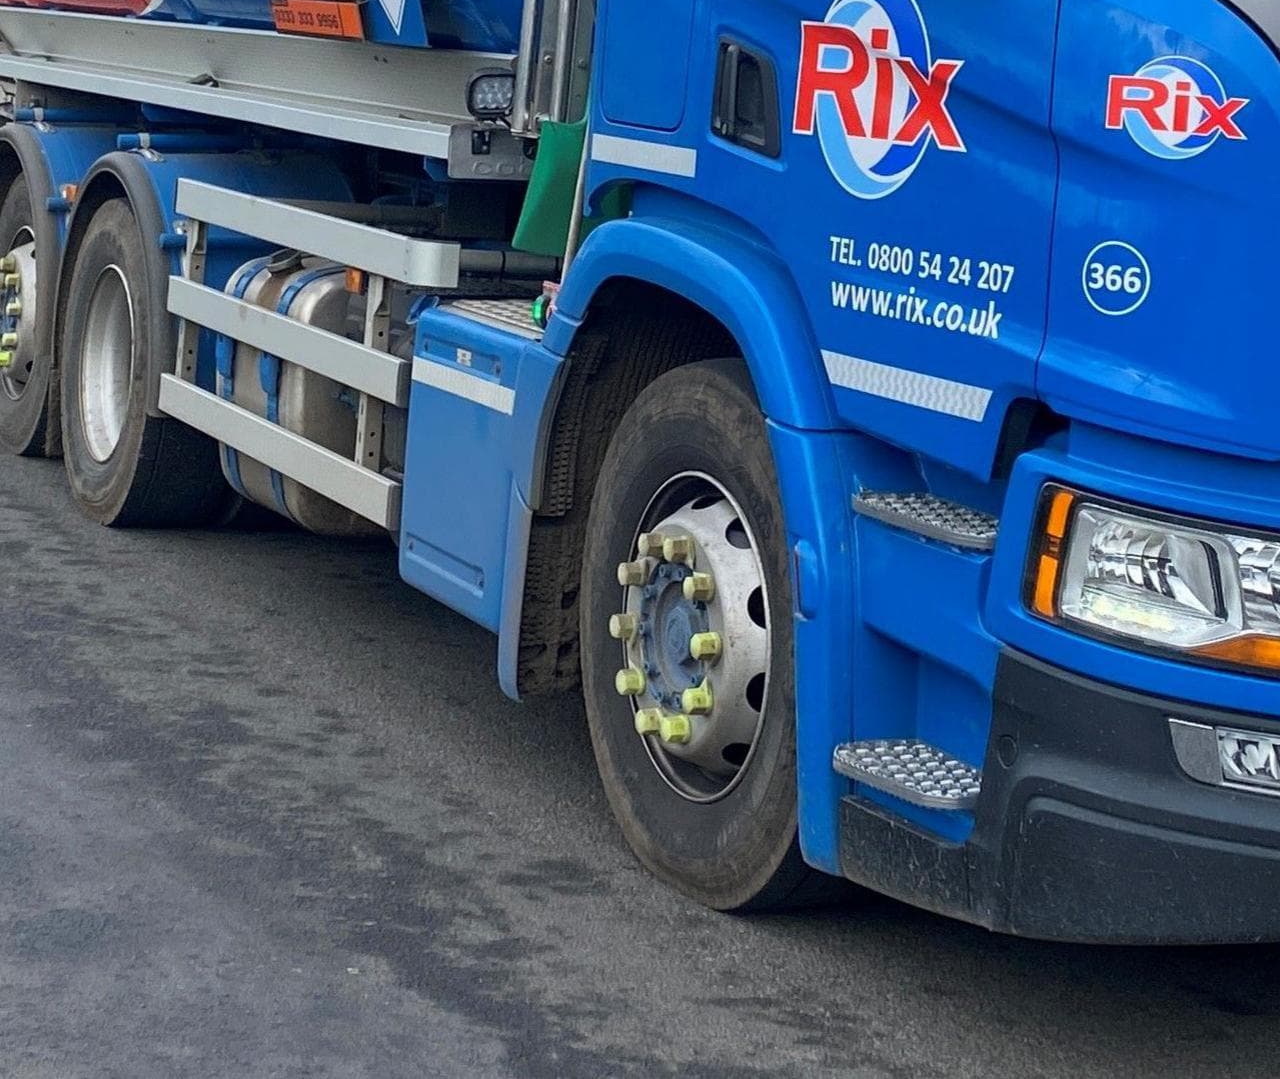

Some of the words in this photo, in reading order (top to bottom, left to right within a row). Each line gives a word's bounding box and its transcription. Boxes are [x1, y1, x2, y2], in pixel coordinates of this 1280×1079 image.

[792, 20, 967, 153] Rix
[1105, 74, 1251, 141] Rix
[830, 235, 862, 267] TEL.
[867, 242, 914, 276] 0800
[918, 251, 942, 281] 54
[947, 256, 972, 287] 24
[976, 261, 1015, 293] 207
[1088, 262, 1142, 294] 366
[831, 281, 1003, 340] www.rix.co.uk
